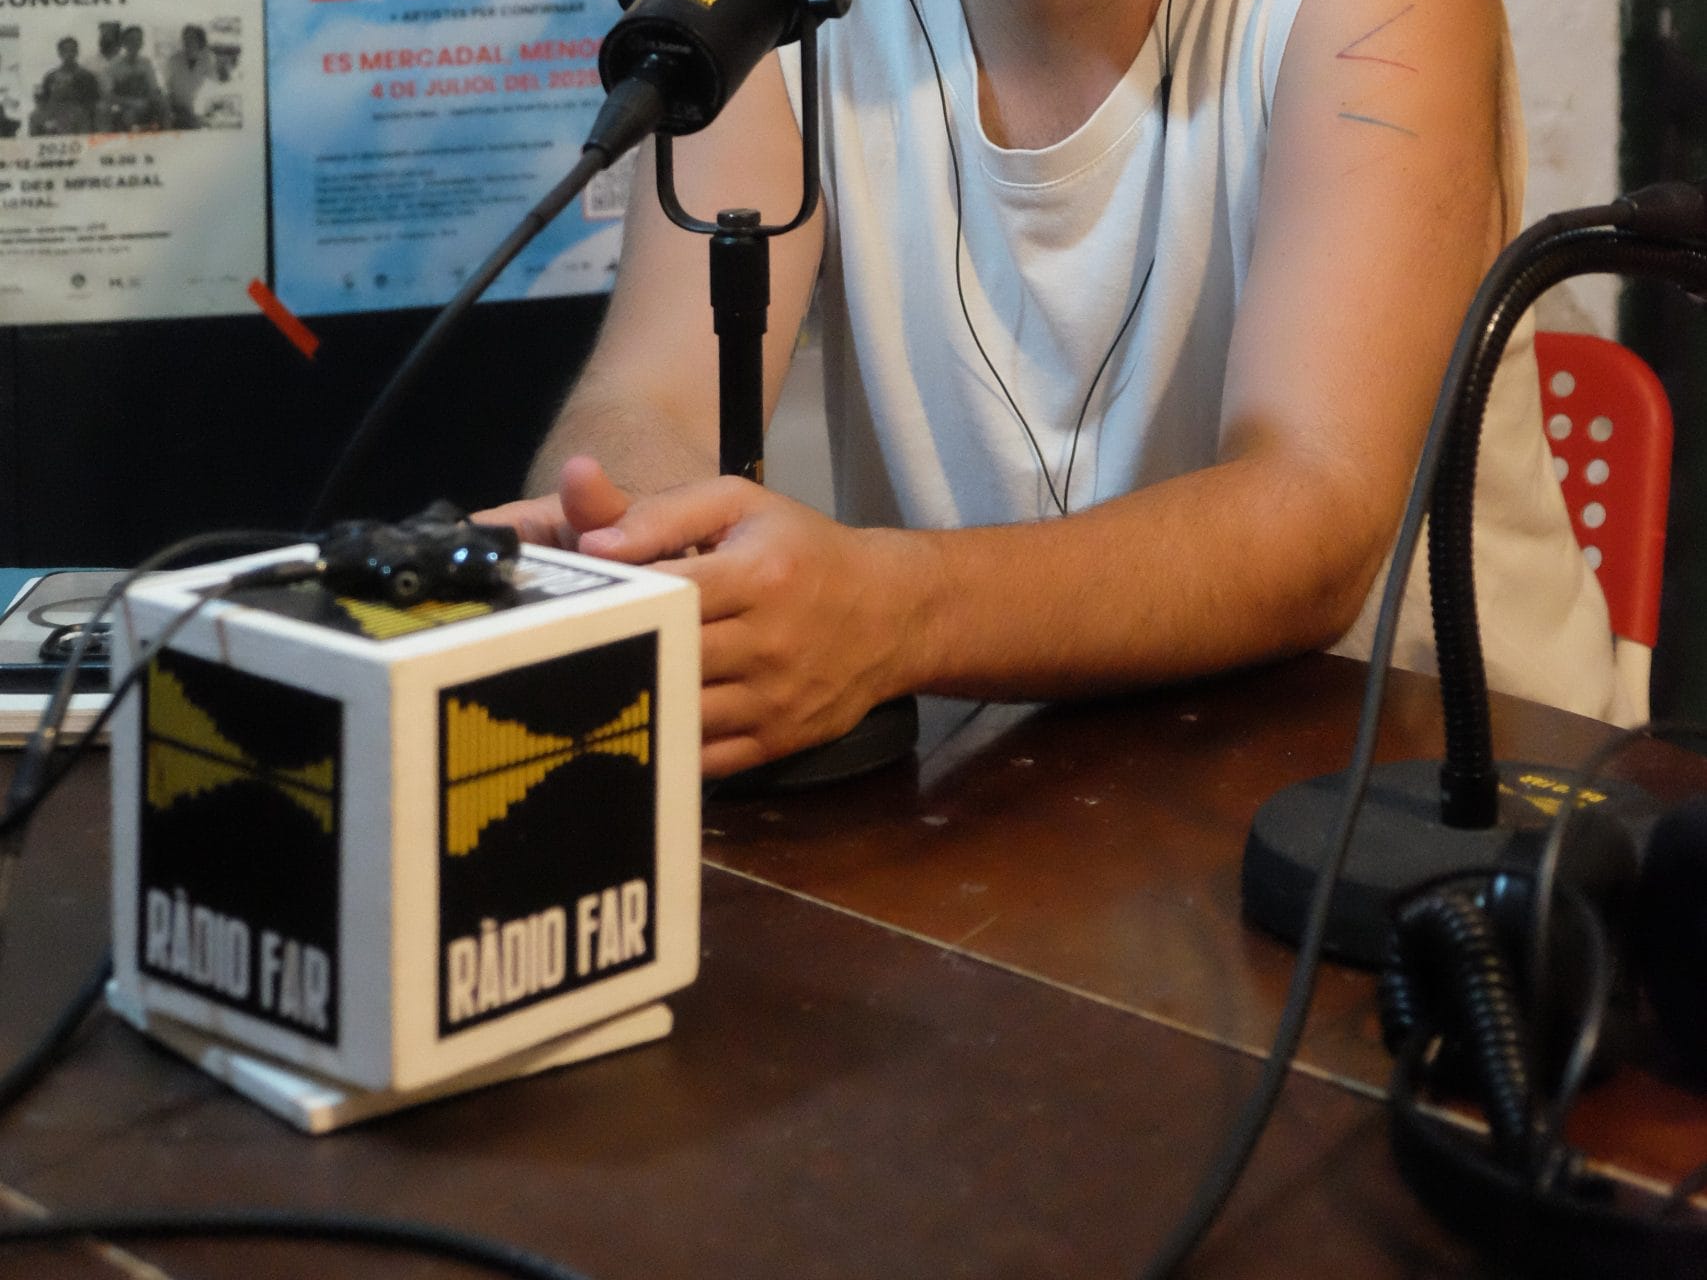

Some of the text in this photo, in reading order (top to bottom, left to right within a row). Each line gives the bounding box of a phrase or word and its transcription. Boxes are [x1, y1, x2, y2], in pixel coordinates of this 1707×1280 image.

[322, 51, 353, 74] ES
[390, 79, 418, 100] DE
[145, 887, 332, 1032] RÀDIO FAR
[447, 879, 650, 1024] RÀDIO FAR
